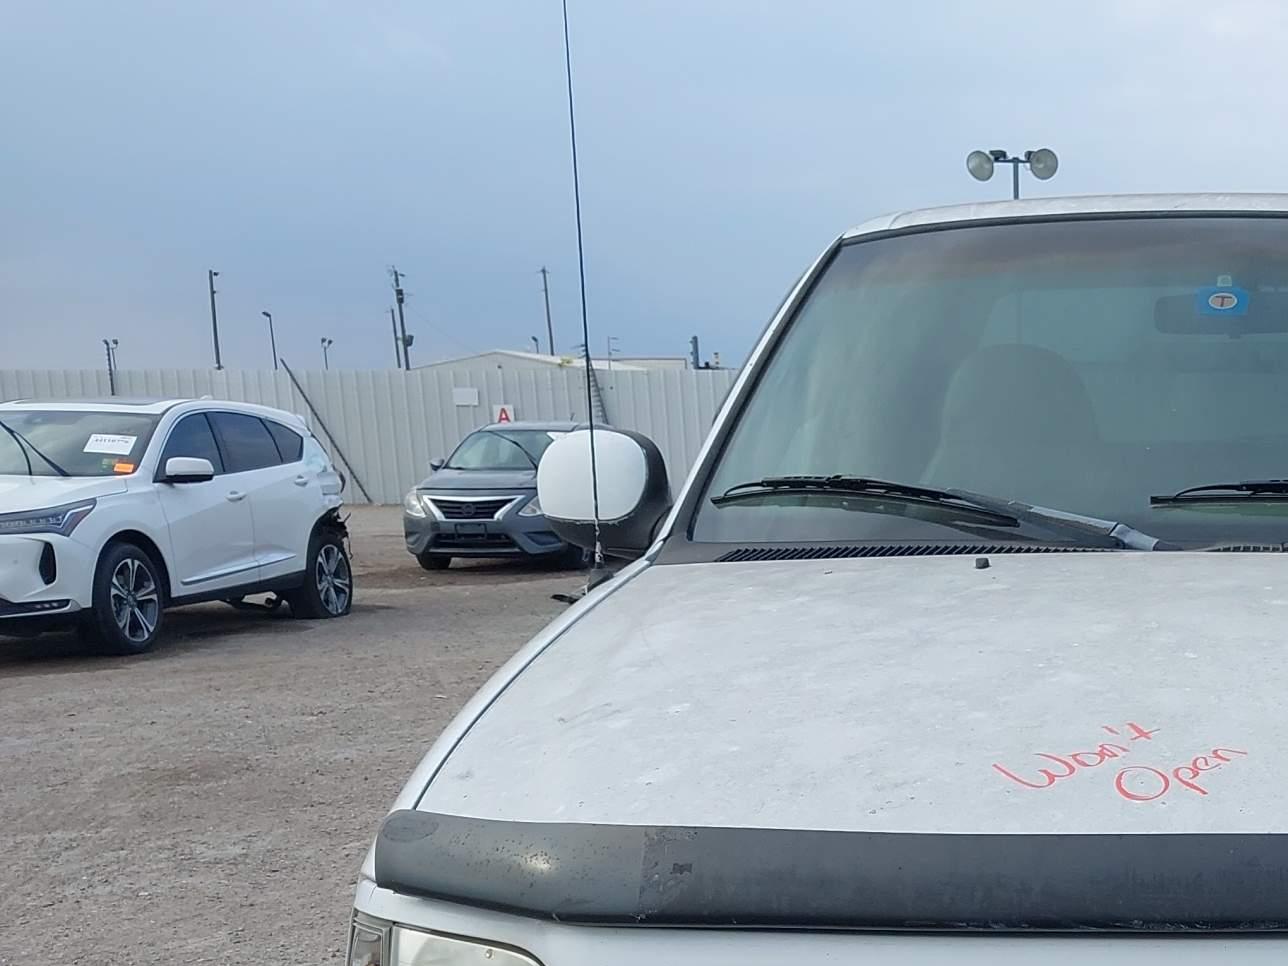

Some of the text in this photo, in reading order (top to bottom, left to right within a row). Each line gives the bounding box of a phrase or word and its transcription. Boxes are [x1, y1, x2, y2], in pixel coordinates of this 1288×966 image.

[497, 407, 512, 424] A
[992, 721, 1161, 789] Won't
[1115, 745, 1248, 802] Open
